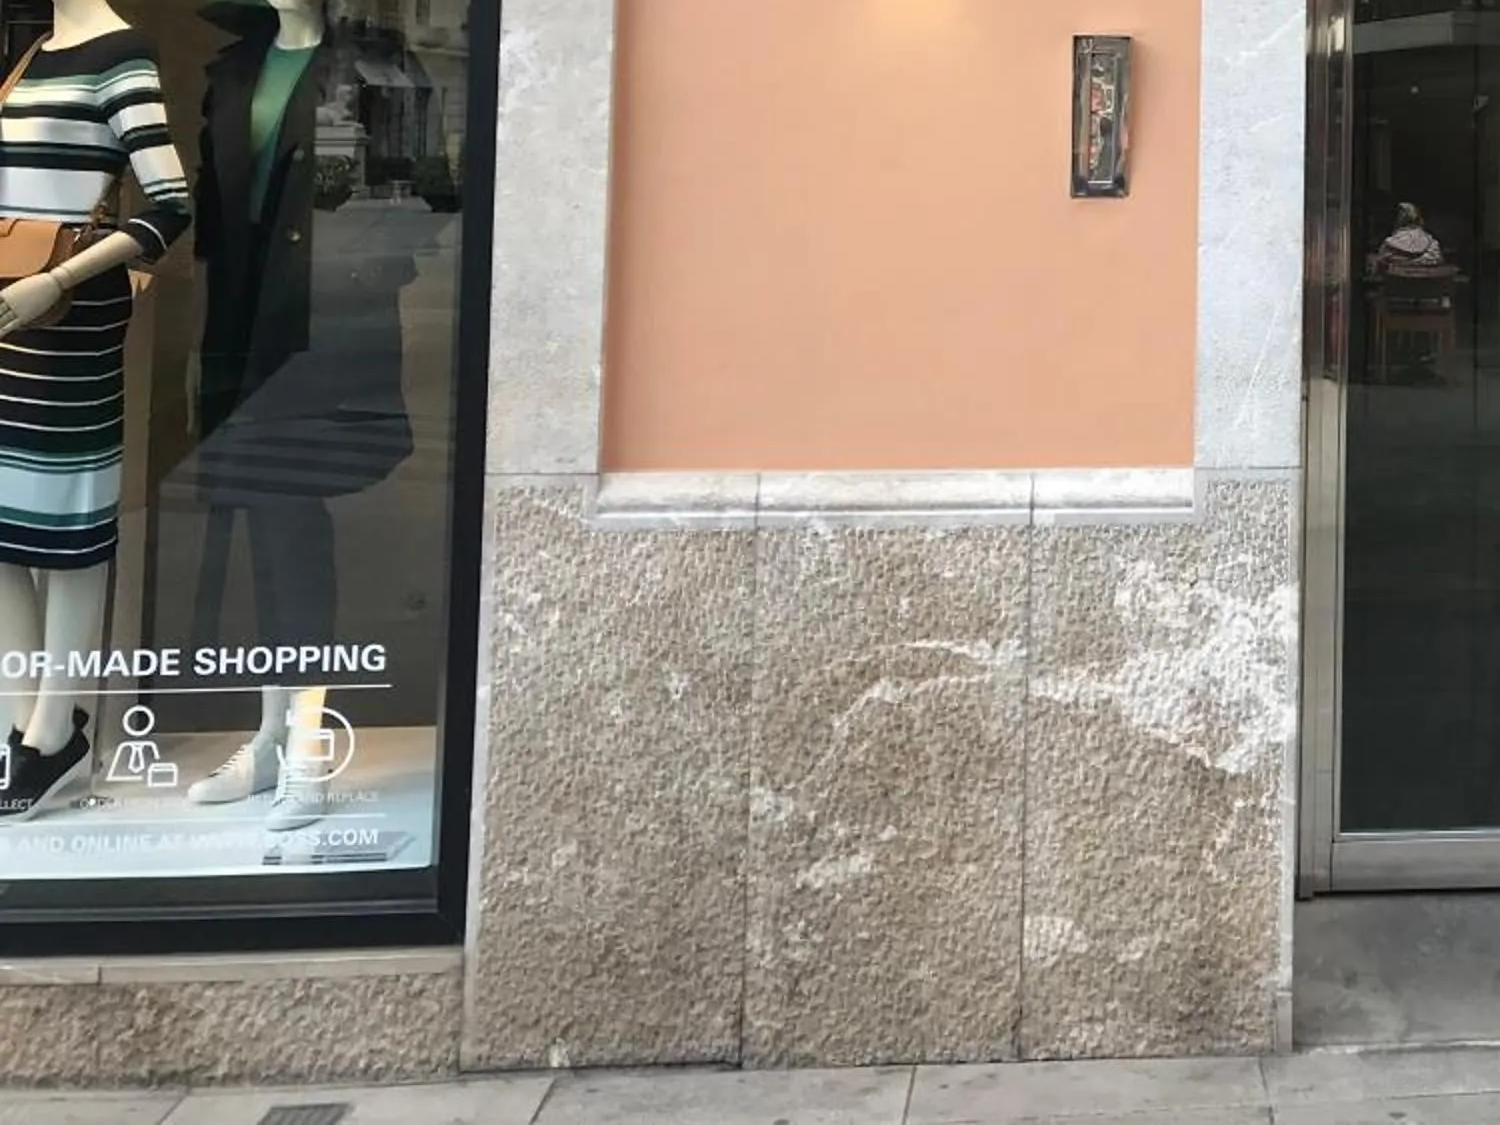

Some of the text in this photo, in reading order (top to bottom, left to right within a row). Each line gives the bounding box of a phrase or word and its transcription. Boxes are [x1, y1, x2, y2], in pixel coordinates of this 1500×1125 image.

[1, 643, 386, 679] OR-MADE SHOPPING
[17, 835, 64, 853] AND
[71, 834, 151, 853] ONLINE
[158, 834, 184, 849] AT
